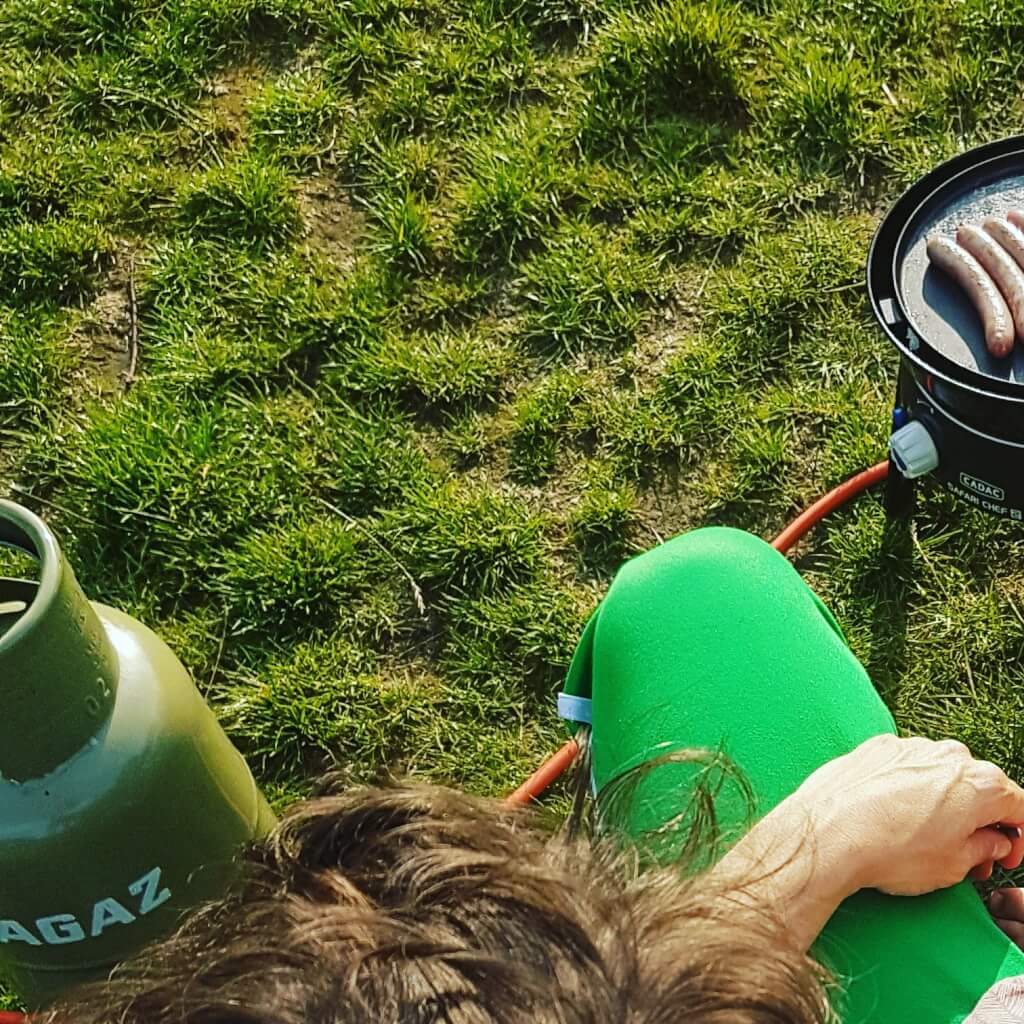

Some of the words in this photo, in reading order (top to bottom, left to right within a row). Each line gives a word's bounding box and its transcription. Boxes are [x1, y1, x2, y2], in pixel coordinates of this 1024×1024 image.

[947, 481, 979, 505] SAFARI
[982, 500, 1008, 514] CHEF
[963, 476, 1001, 498] CADAC
[0, 866, 172, 945] AGAZ
